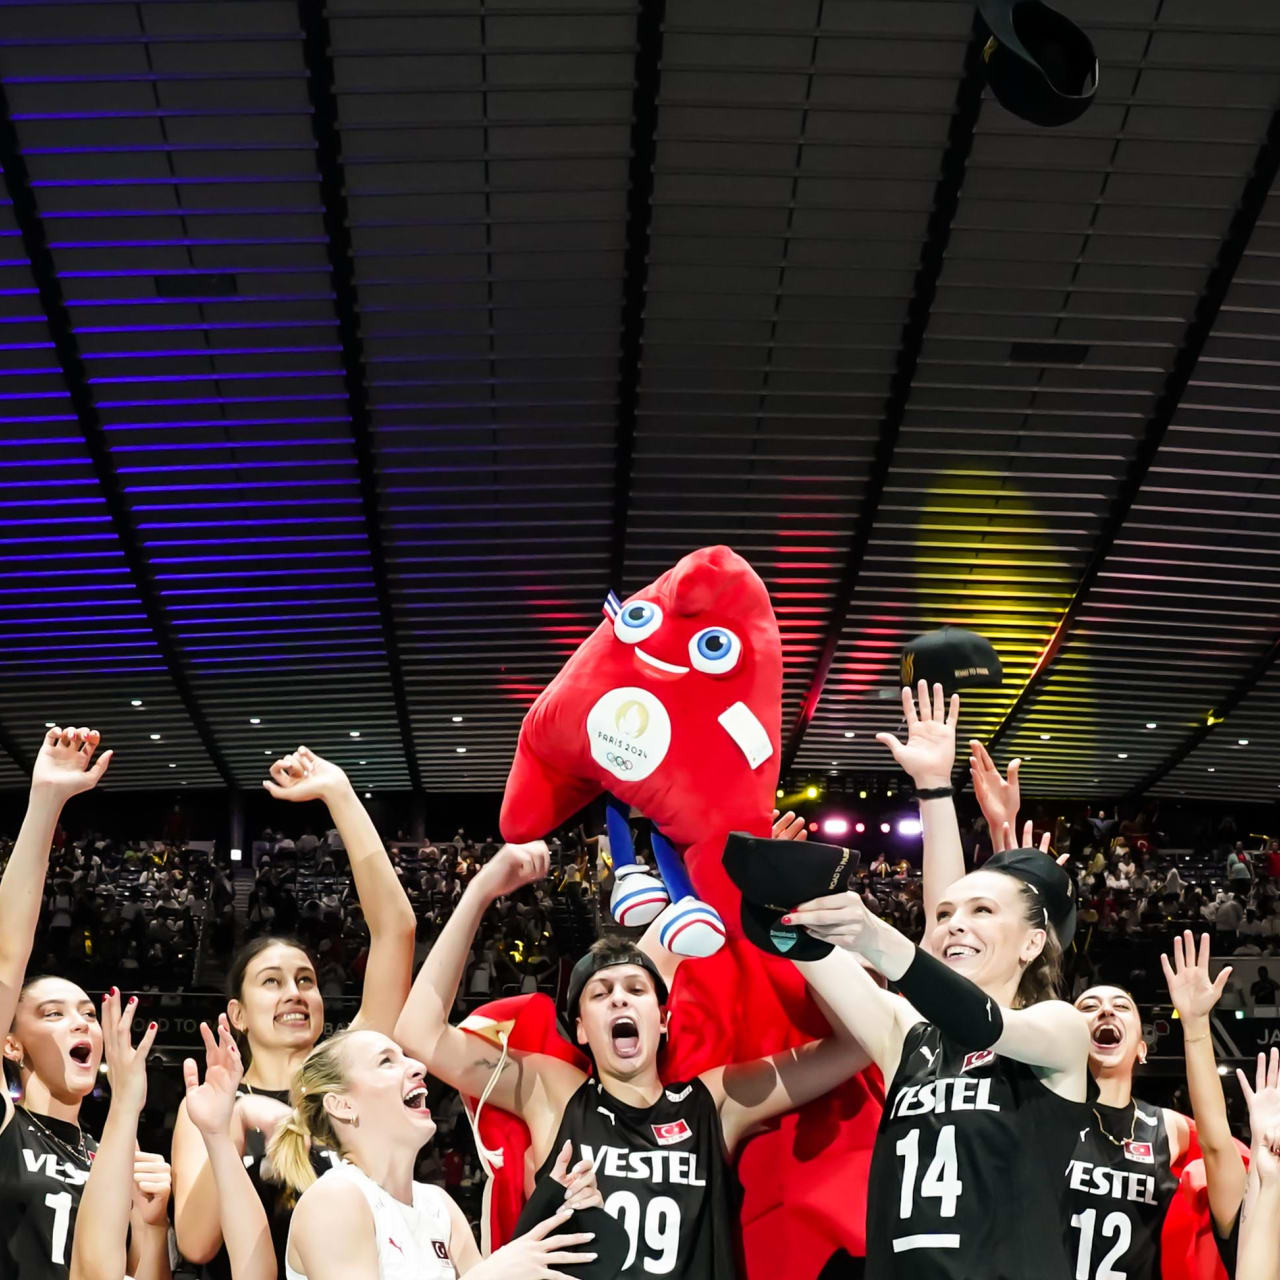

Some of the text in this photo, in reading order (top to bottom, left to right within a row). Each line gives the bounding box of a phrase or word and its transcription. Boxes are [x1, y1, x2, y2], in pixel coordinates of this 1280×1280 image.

[598, 731, 647, 759] PARIS 2024
[580, 1143, 707, 1187] VESTEL
[895, 1124, 963, 1220] 14
